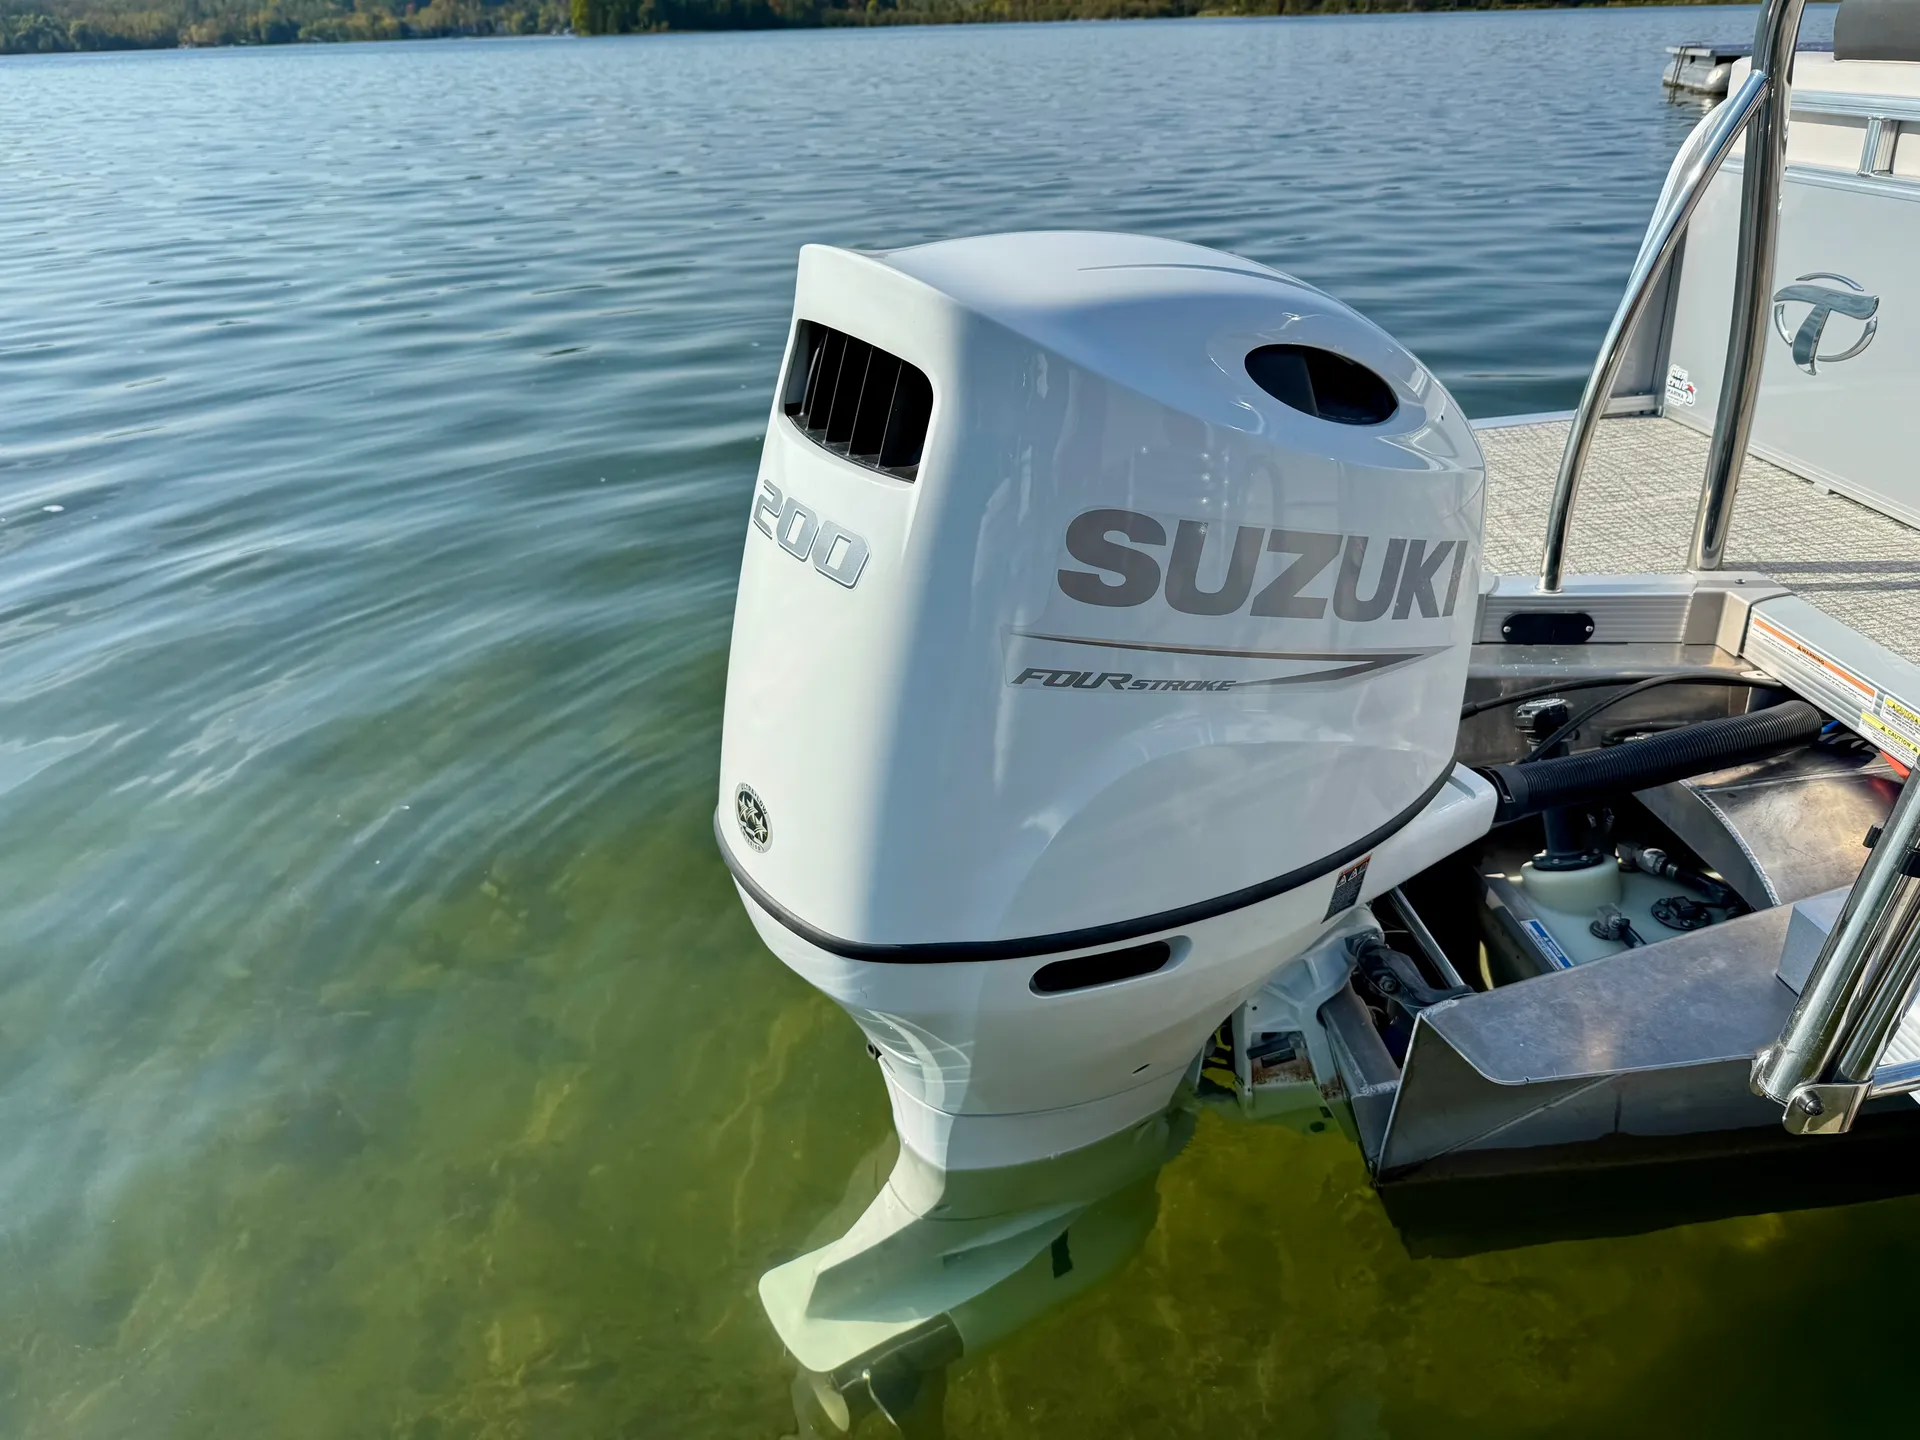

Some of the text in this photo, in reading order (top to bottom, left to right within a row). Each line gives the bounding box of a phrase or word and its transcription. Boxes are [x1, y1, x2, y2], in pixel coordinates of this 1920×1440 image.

[753, 478, 872, 590] 200
[1057, 508, 1469, 622] SUZUKI
[1801, 648, 1825, 666] WARNING
[1888, 730, 1911, 747] CAUTION
